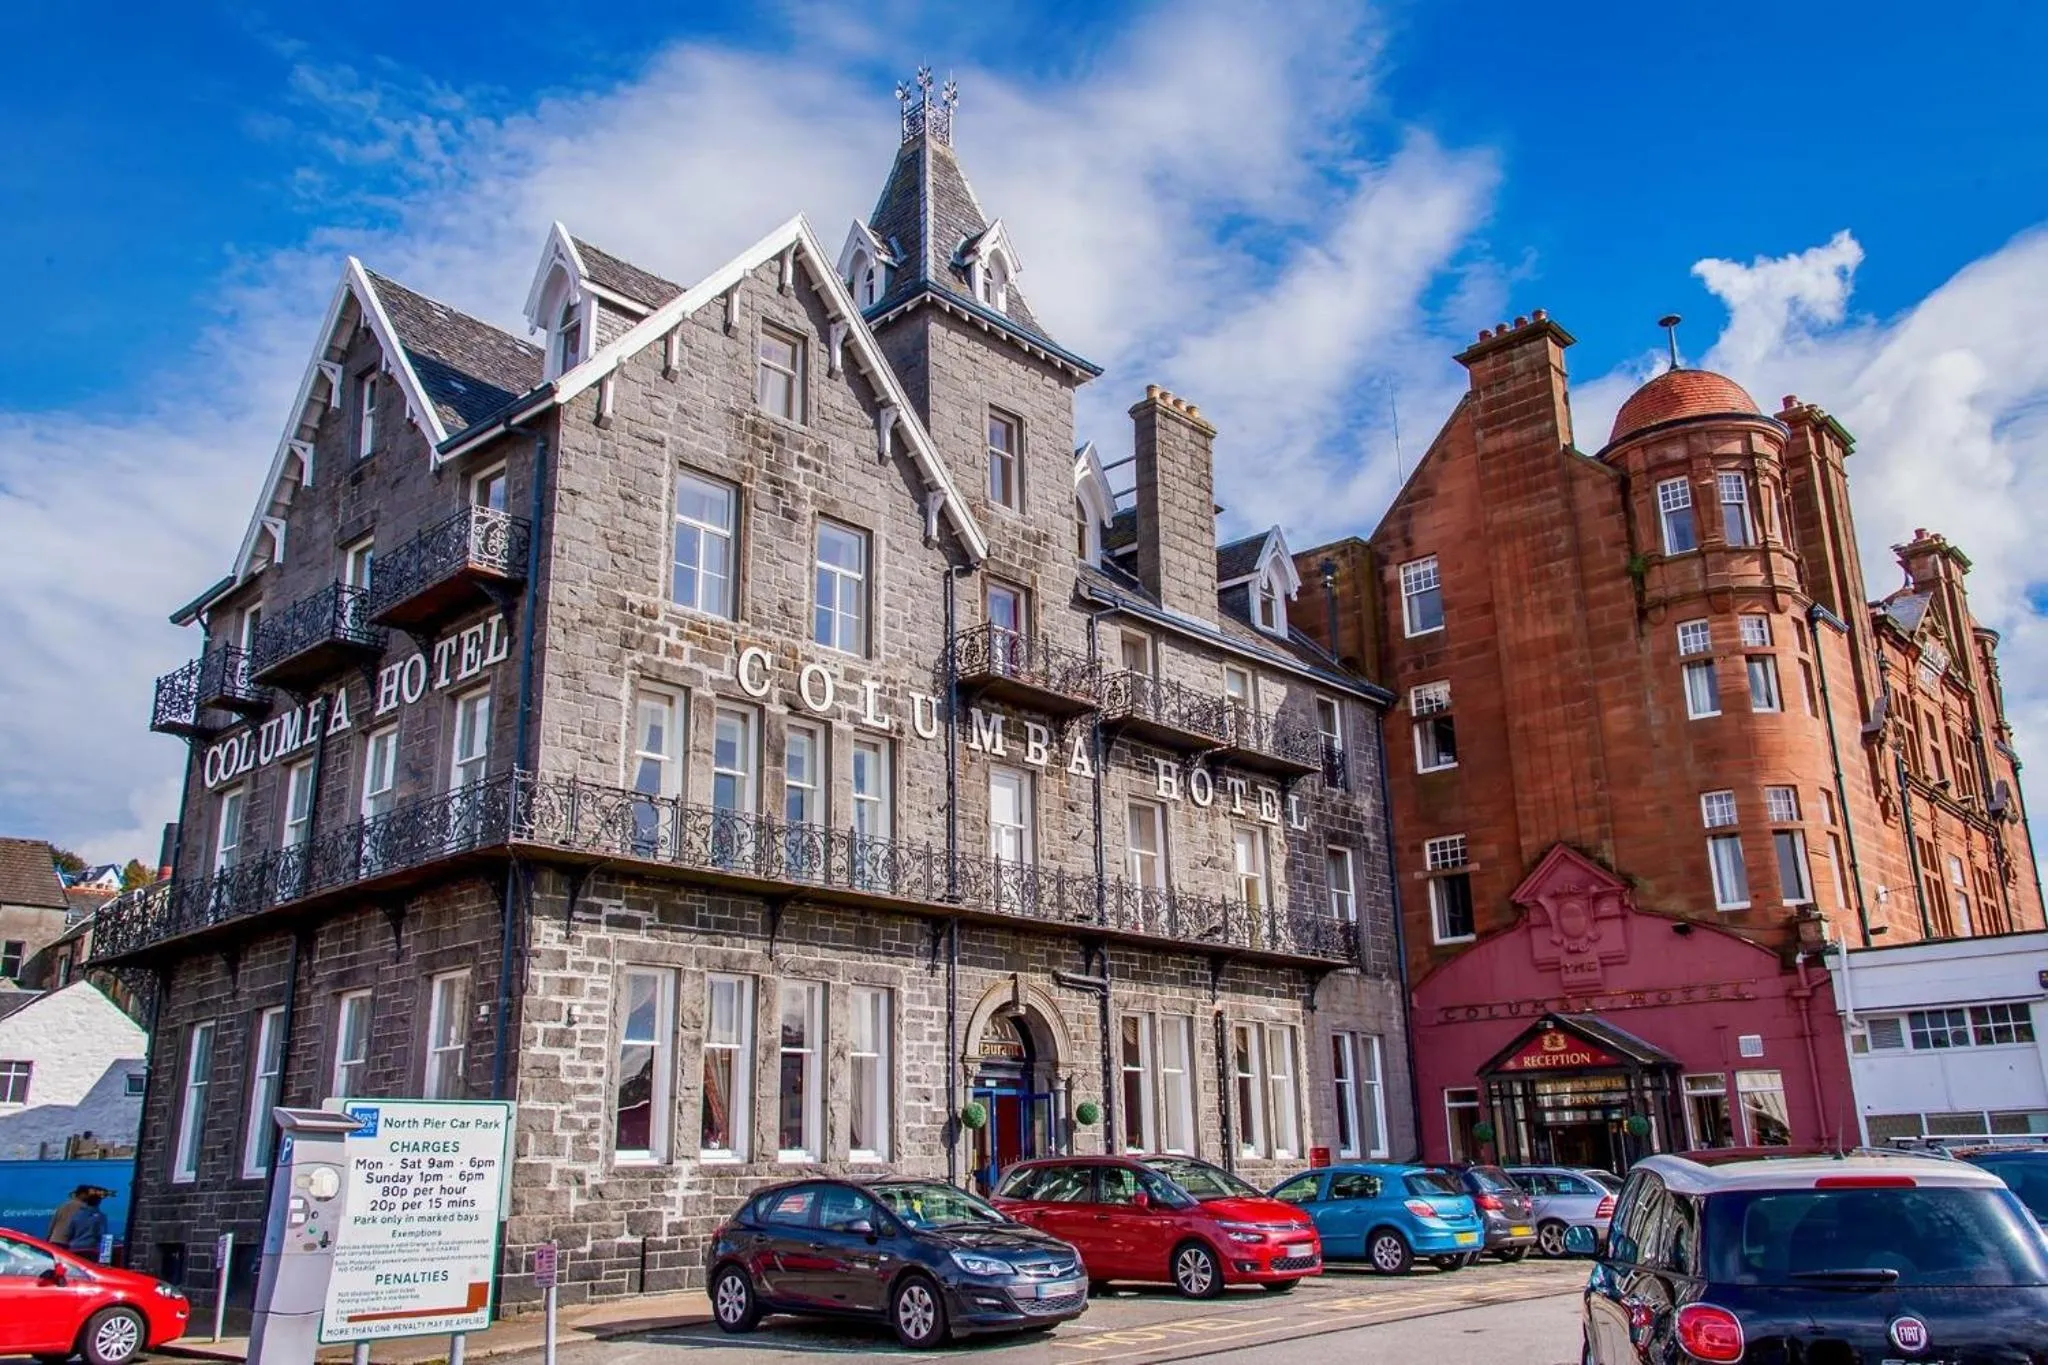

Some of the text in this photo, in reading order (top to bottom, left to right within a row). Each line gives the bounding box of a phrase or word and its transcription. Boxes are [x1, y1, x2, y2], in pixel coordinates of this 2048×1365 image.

[375, 613, 509, 716] HOTEL
[737, 646, 1309, 831] COLUMBA HOTEL
[1523, 1053, 1591, 1067] RECEPTION
[384, 1117, 419, 1129] North
[423, 1117, 446, 1129] Pier
[450, 1118, 471, 1129] Car
[475, 1118, 500, 1129] Park
[389, 1141, 460, 1153] CHARGES
[355, 1158, 383, 1170] Mon
[400, 1158, 422, 1169] Sat
[427, 1158, 454, 1168] 9am
[469, 1157, 495, 1169] 6pm
[365, 1172, 414, 1185] Sunday
[419, 1173, 443, 1184] 1pm
[458, 1171, 485, 1183] 6pm
[381, 1185, 467, 1198] 80p per hour
[370, 1199, 476, 1213] 20p per 15 mins
[354, 1212, 479, 1226] Park only in marked bays
[391, 1229, 442, 1239] Exemptions
[375, 1270, 449, 1285] PENALTIES
[326, 1328, 350, 1336] MORE
[352, 1326, 374, 1334] THAN
[393, 1321, 425, 1330] PENALTY
[1899, 1326, 1919, 1342] FIAT
